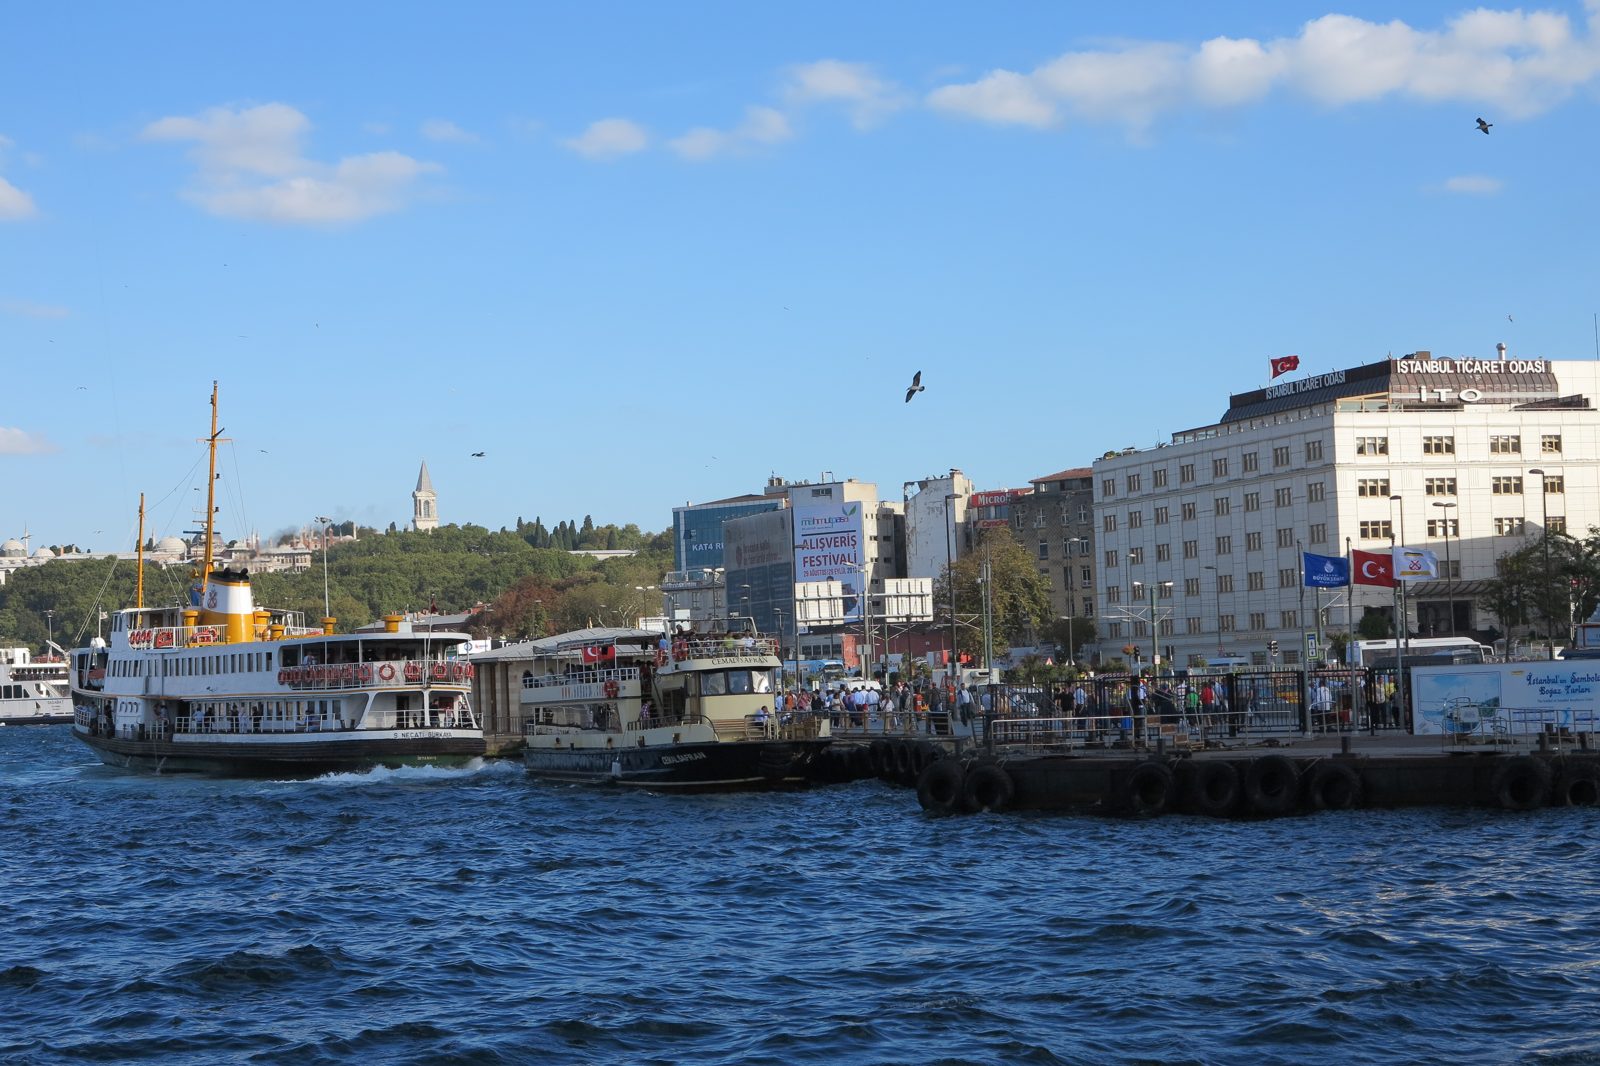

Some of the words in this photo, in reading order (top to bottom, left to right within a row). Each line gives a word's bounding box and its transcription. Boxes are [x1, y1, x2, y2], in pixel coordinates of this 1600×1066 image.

[1509, 360, 1546, 374] ODASI
[692, 543, 713, 551] KAT4
[801, 533, 857, 552] ALIŞVERİŞ
